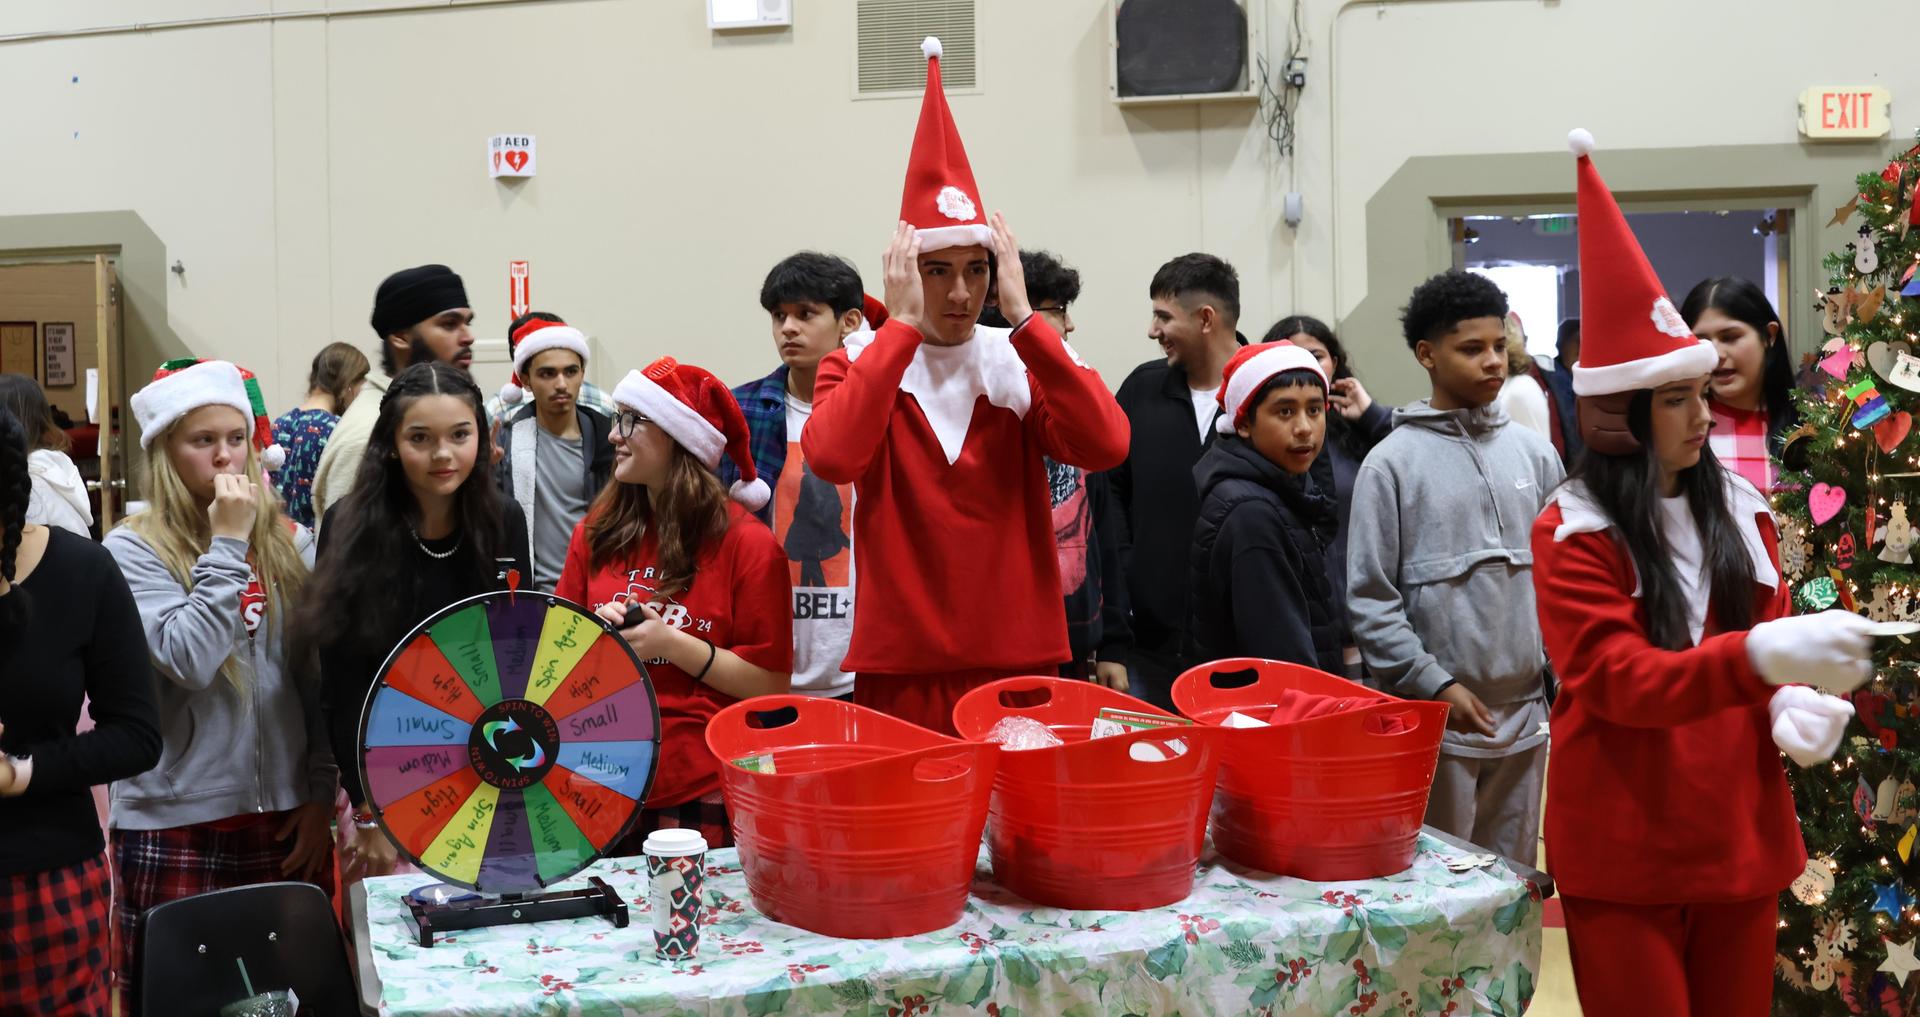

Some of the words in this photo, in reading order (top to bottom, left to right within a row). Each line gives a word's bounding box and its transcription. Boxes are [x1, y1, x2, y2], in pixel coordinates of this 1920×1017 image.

[1822, 92, 1872, 128] EXIT
[505, 136, 529, 147] AED
[793, 592, 847, 619] BEL
[458, 641, 489, 688] Small
[505, 626, 527, 675] Medium
[535, 659, 559, 688] Spin
[553, 614, 584, 652] Again
[432, 673, 462, 704] High
[569, 676, 600, 699] High
[498, 702, 527, 713] SPIN
[530, 705, 544, 718] TO
[570, 703, 618, 736] Small
[397, 717, 455, 740] Small
[398, 750, 452, 774] Medium
[484, 771, 498, 784] TO
[581, 751, 629, 776] Medium
[502, 776, 529, 787] SPIN
[420, 785, 460, 817] High
[467, 798, 494, 830] Spin
[559, 780, 602, 819] Small
[499, 801, 518, 852] Small
[534, 802, 562, 853] Medium
[439, 833, 476, 869] Again
